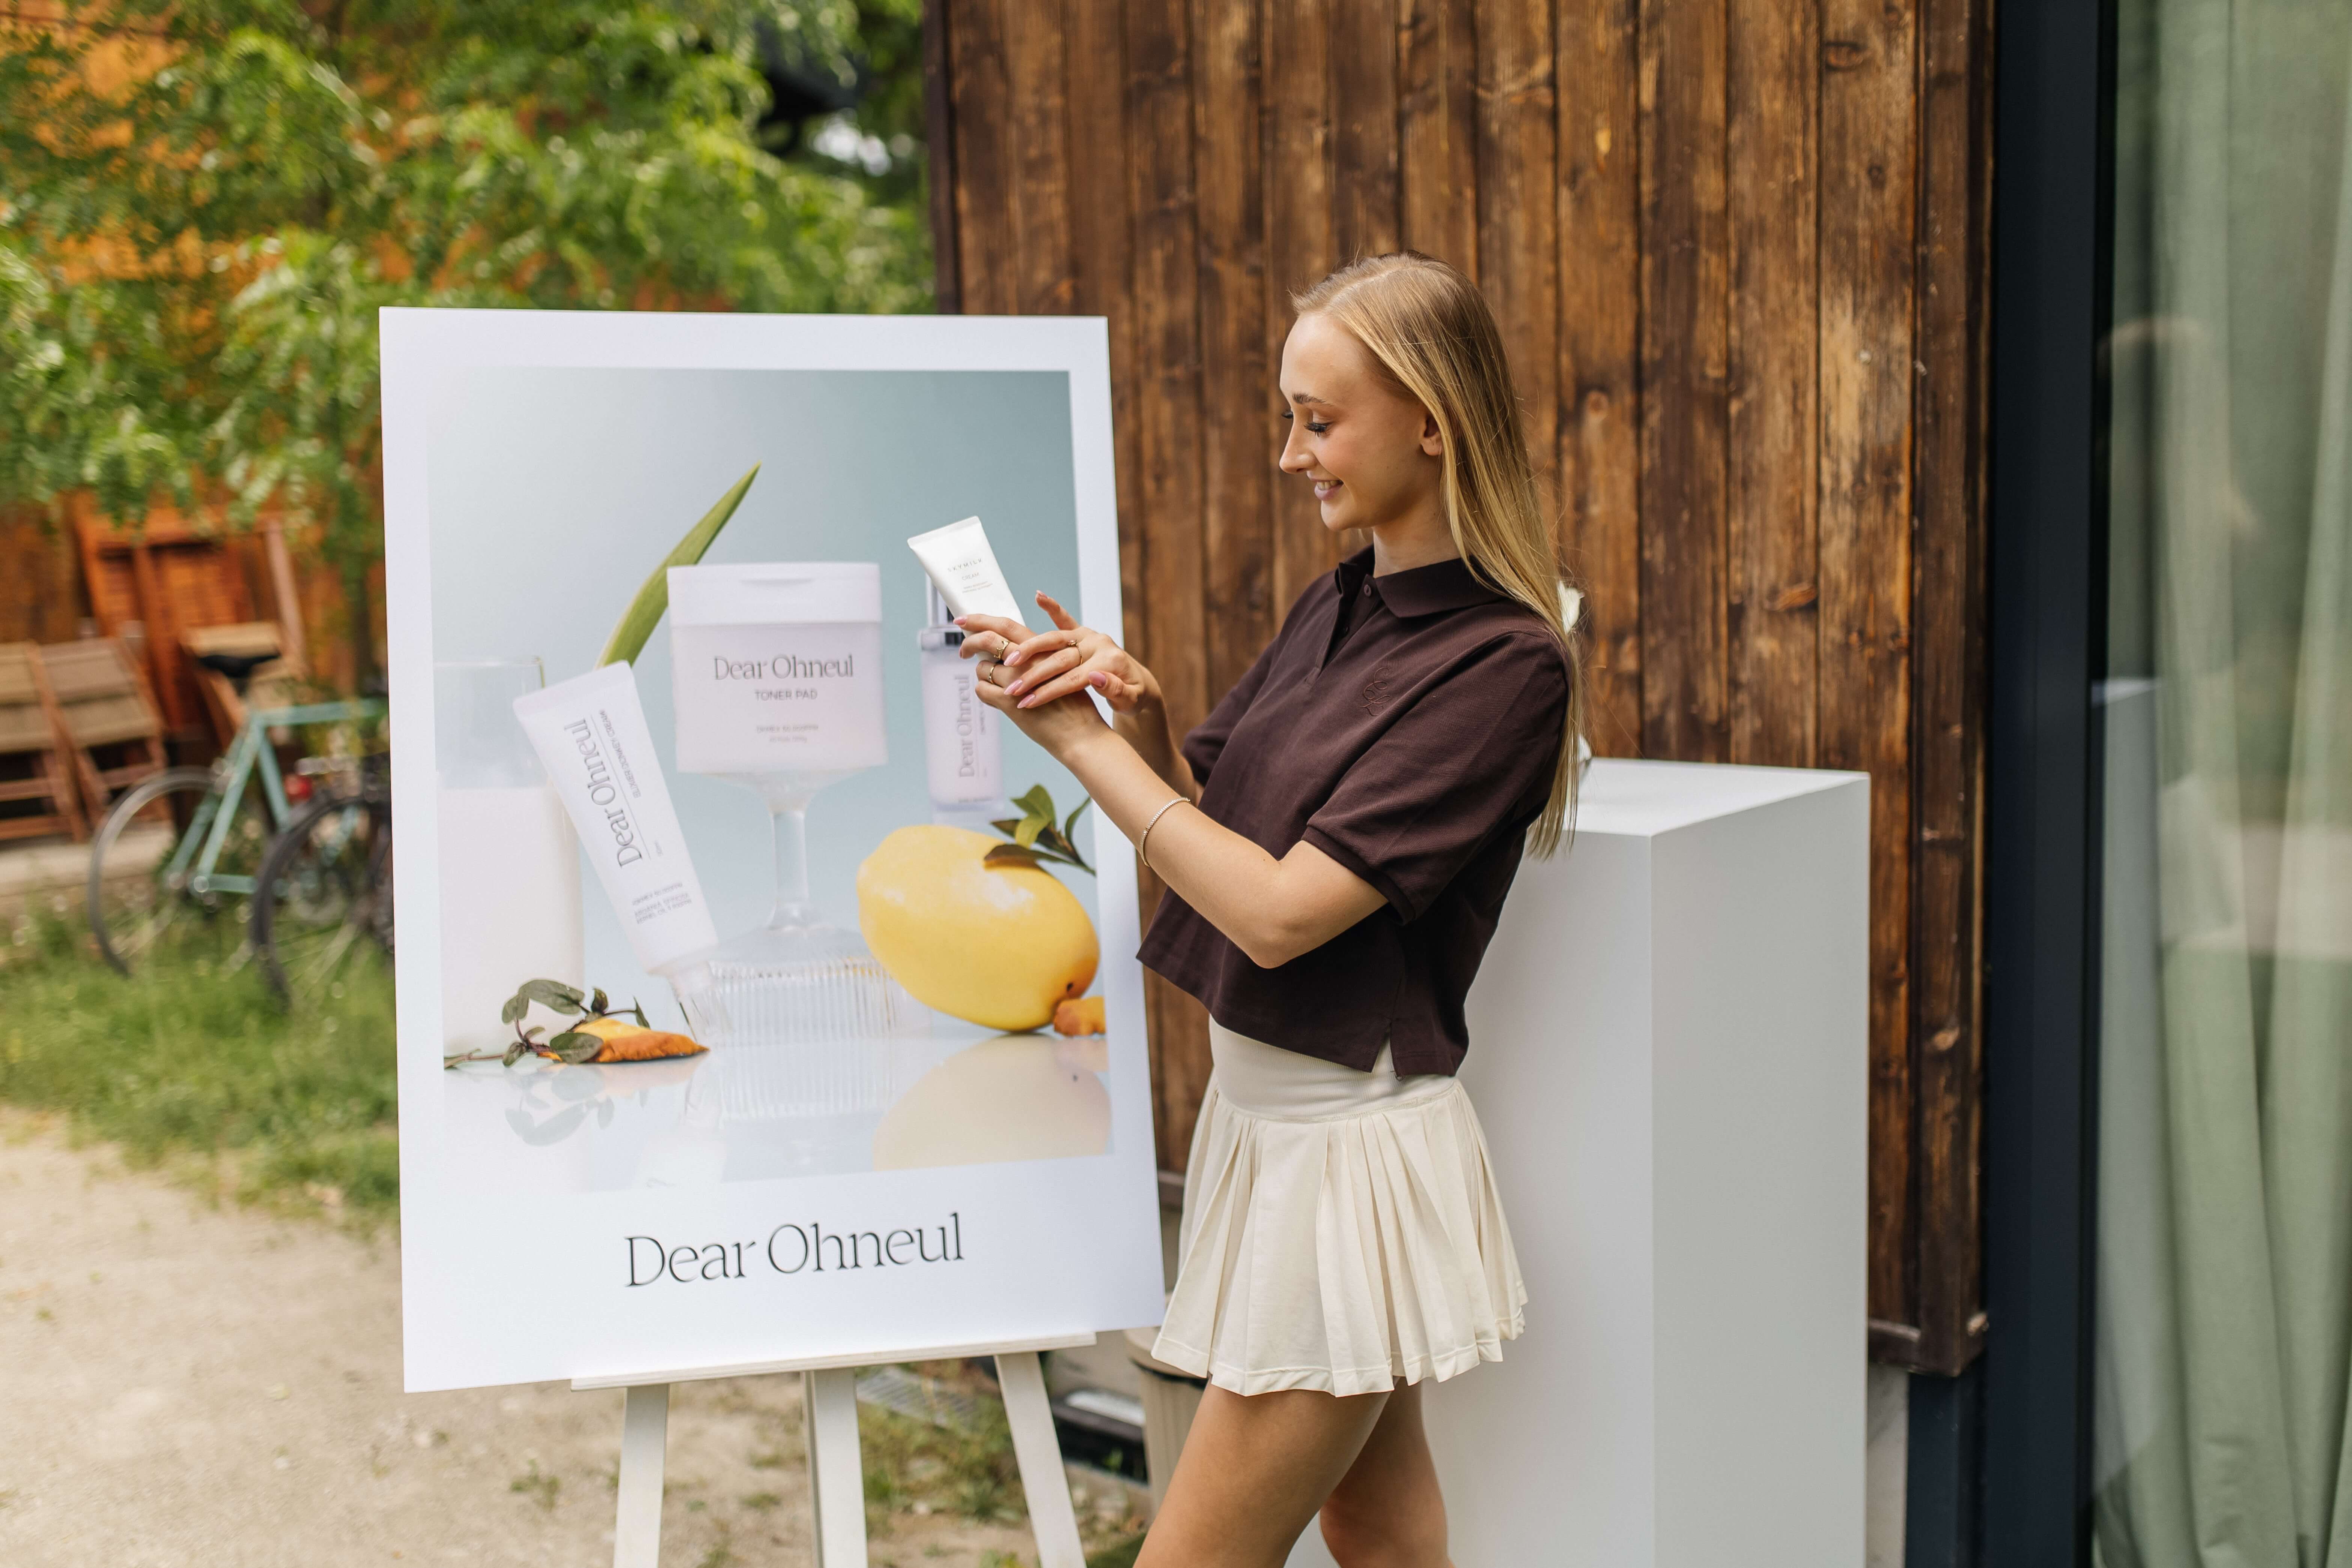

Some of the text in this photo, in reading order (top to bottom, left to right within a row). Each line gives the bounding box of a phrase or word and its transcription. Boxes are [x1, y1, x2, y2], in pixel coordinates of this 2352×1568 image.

[714, 653, 854, 680] Dear Ohneul
[754, 688, 817, 701] TONER PAD
[599, 710, 615, 737] CREAM
[954, 674, 975, 778] Dear Ohneul
[610, 737, 629, 769] DONKEY
[564, 717, 643, 868] Dear Ohneul
[625, 1212, 965, 1287] Dear Ohneul
